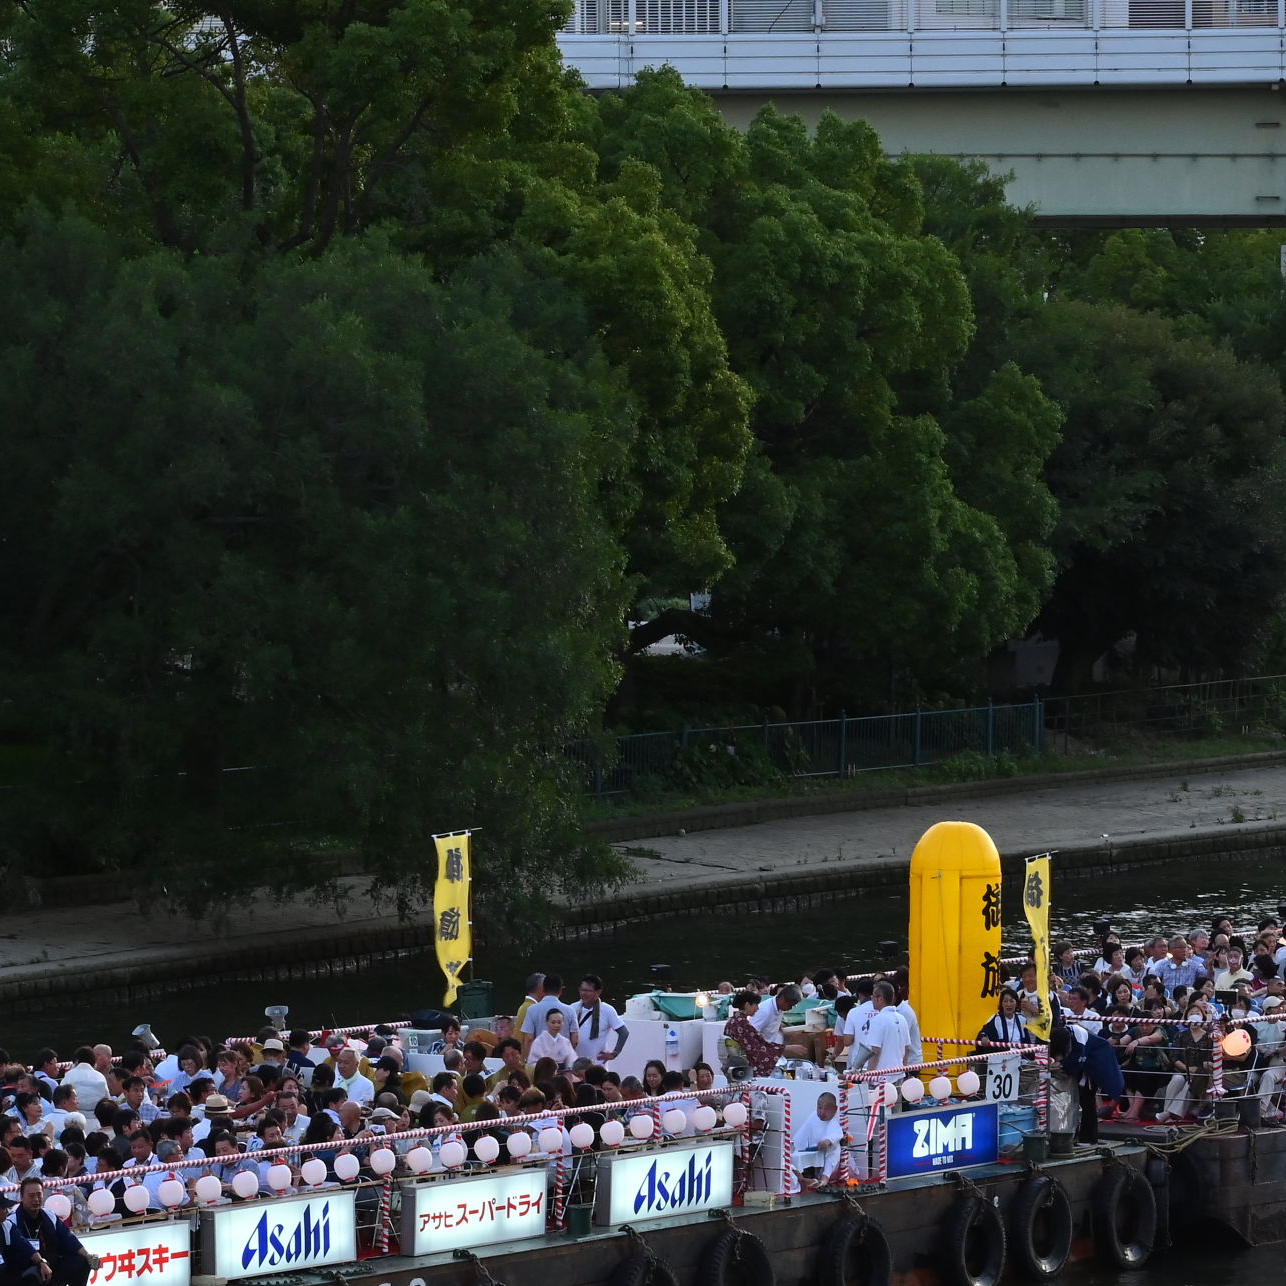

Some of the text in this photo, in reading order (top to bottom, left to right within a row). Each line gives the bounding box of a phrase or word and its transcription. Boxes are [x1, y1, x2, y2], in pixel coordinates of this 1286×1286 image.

[993, 1074, 1012, 1099] 30
[913, 1113, 973, 1157] ZIMA
[634, 1150, 712, 1216] Asahi
[419, 1191, 545, 1233] アサヒスーパードライ
[242, 1200, 330, 1270] Asahi
